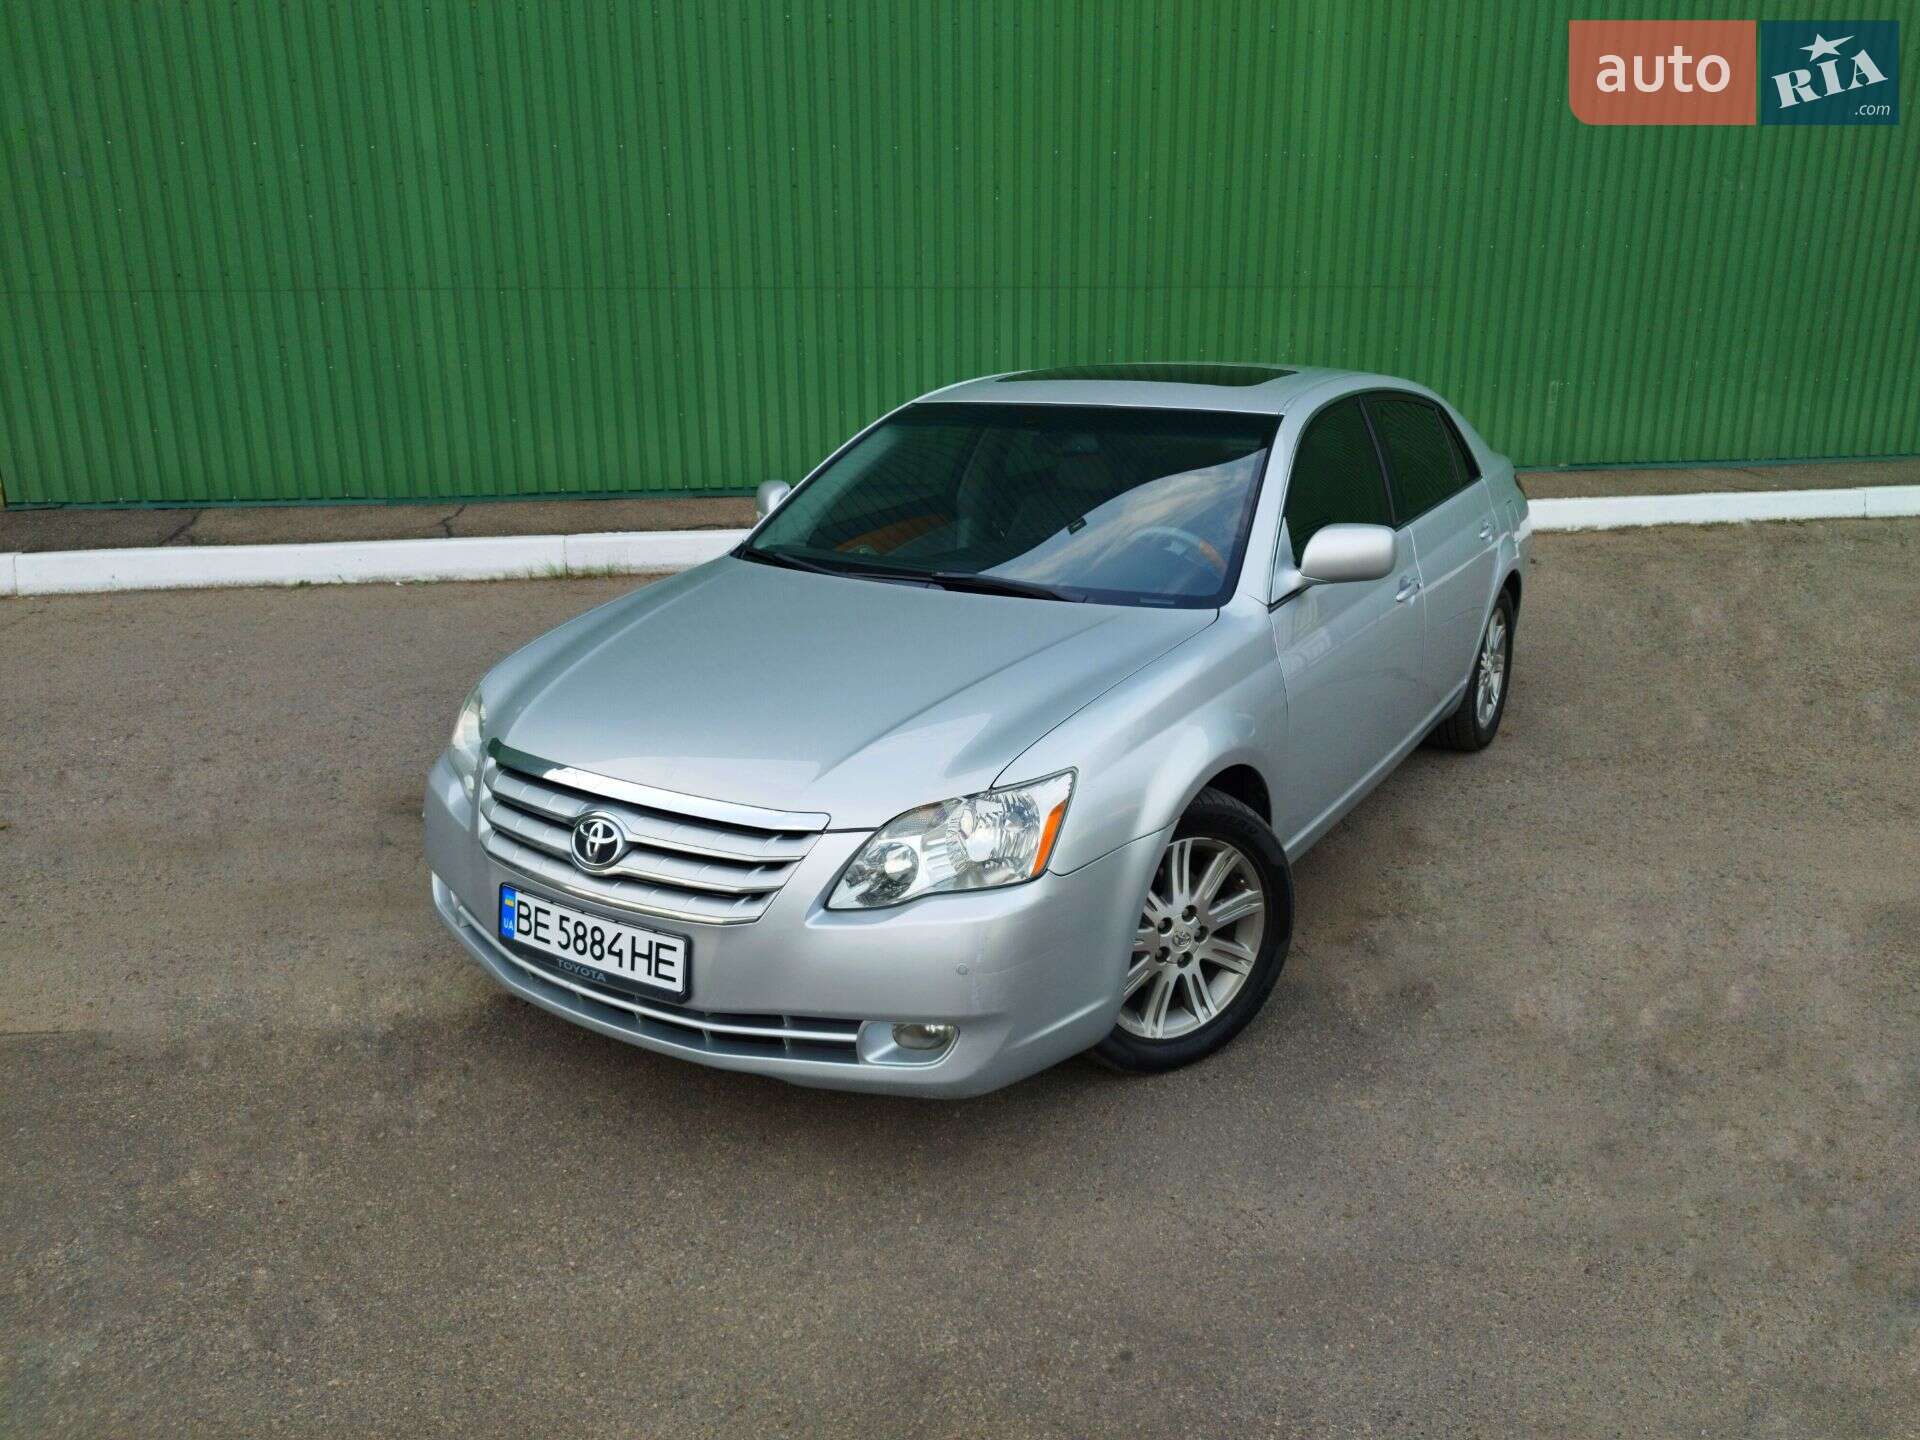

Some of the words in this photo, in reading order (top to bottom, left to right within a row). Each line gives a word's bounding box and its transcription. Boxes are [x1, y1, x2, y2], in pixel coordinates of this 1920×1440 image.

[503, 917, 514, 930] UA
[516, 900, 551, 944] BE
[557, 914, 624, 968] 5884
[630, 935, 677, 983] HE
[557, 958, 606, 983] TOYOTA
